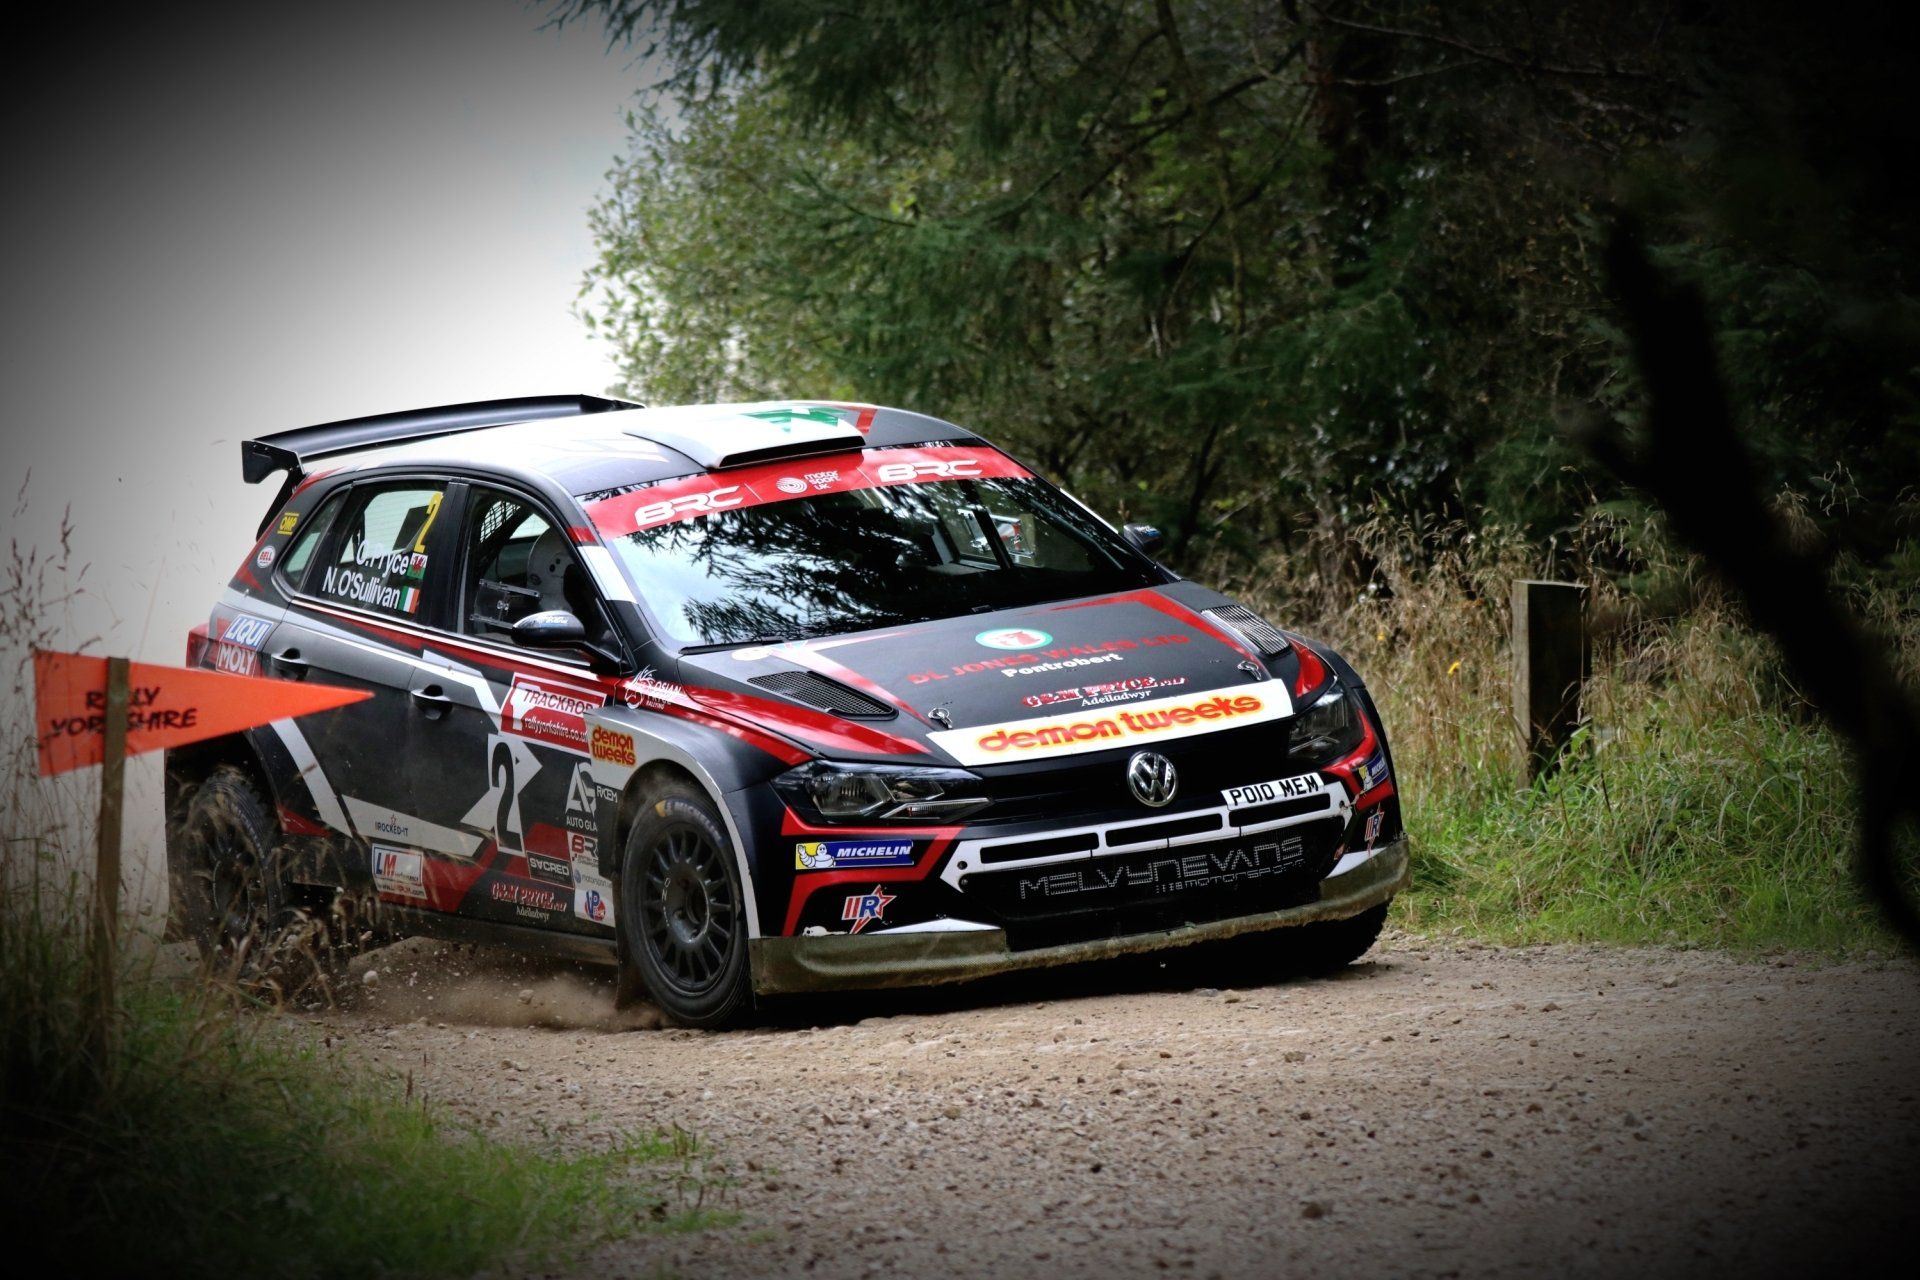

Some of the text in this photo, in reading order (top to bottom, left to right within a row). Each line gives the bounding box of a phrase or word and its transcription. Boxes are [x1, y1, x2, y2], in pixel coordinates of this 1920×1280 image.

[804, 470, 838, 480] motor
[878, 459, 982, 483] BRC
[634, 486, 743, 529] BRC
[279, 515, 298, 534] OMP
[413, 490, 444, 554] 2
[338, 569, 402, 610] O'Sullivan
[224, 615, 273, 648] LIQUI
[218, 643, 256, 675] MOLY
[1001, 652, 1123, 679] Pontrobert
[906, 668, 939, 685] DL
[85, 686, 161, 711] RLY
[1081, 690, 1152, 708] Adeiladwyr
[50, 707, 198, 737] YORSHIRE
[978, 692, 1262, 752] demon tweeks
[591, 724, 634, 750] demon
[591, 743, 637, 767] tweeks
[491, 741, 524, 853] 2
[1231, 775, 1320, 807] PO10 MEM
[566, 814, 584, 830] AUTO
[571, 834, 599, 860] BR
[836, 845, 912, 859] MICHELIN
[529, 857, 570, 876] SACRED
